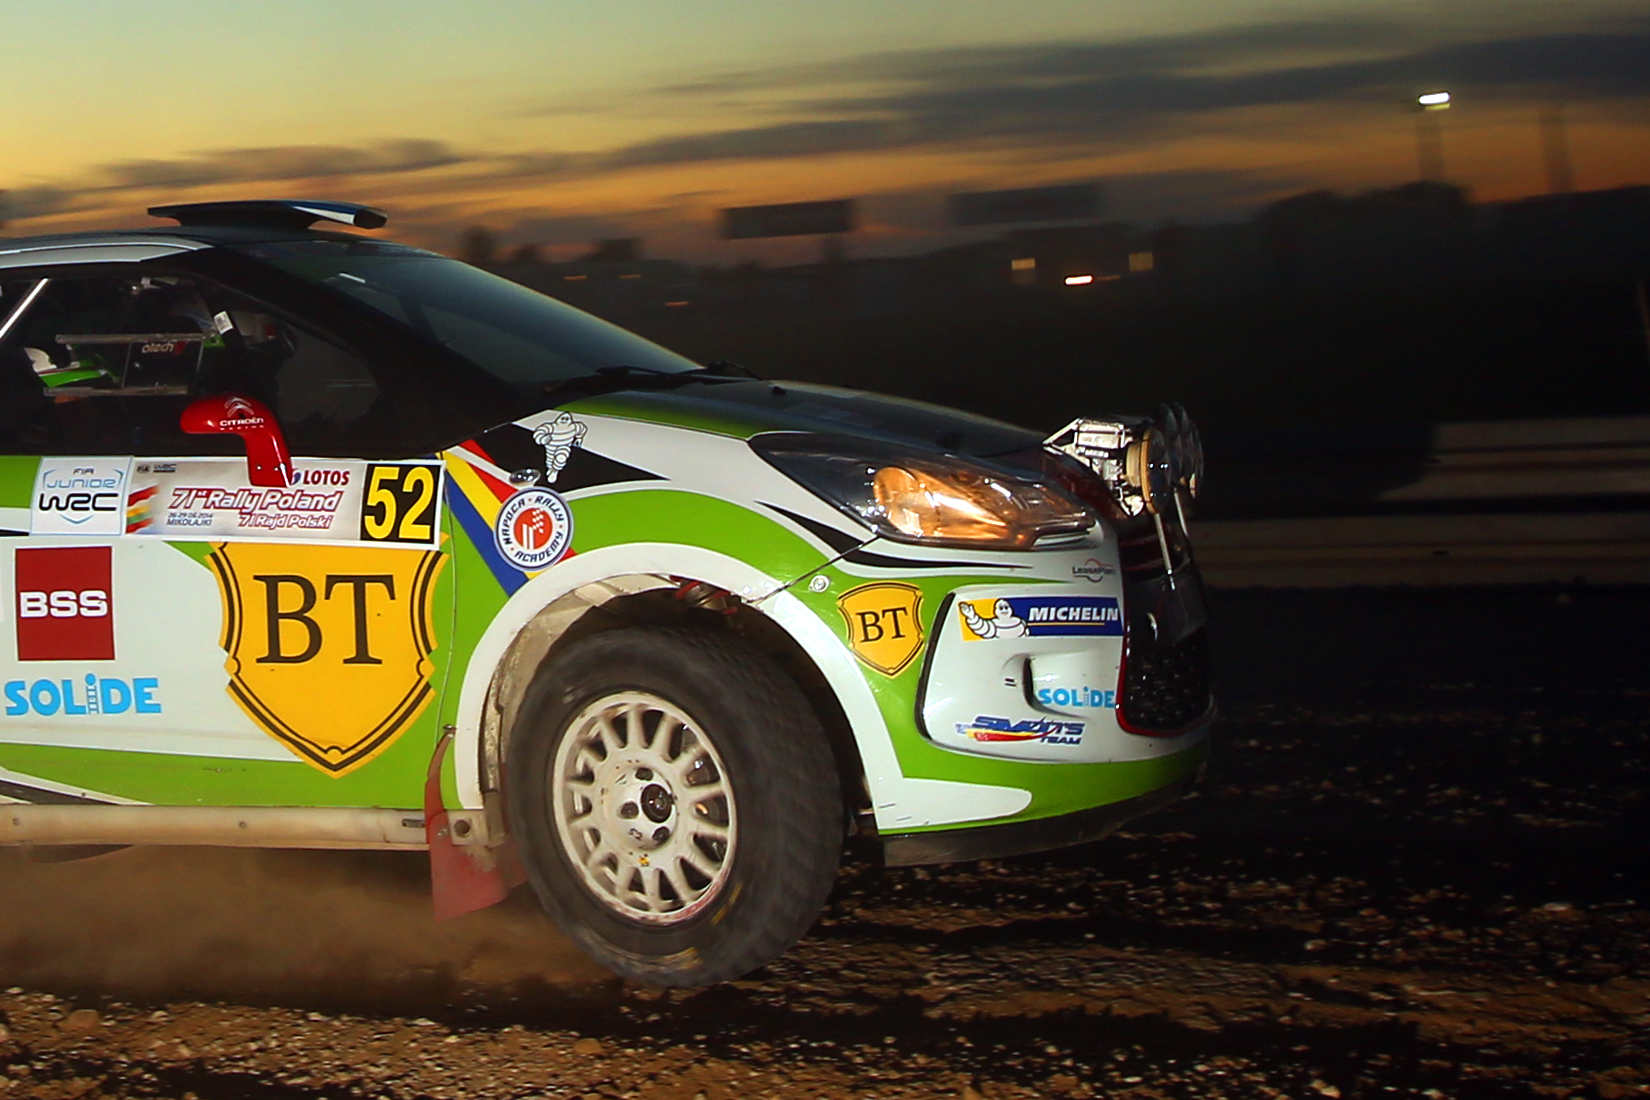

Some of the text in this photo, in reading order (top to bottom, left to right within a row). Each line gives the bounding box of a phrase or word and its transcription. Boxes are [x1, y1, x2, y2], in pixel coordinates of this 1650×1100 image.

[47, 479, 117, 488] JUNIOR
[303, 470, 350, 486] LOTOS
[39, 493, 119, 511] WRC
[203, 488, 262, 514] Rally
[259, 489, 344, 512] Poland
[364, 467, 434, 539] 52
[239, 514, 334, 530] 71 Rajd Polski
[502, 495, 564, 545] NAPOCA RALLY
[514, 532, 564, 562] ACADEMY
[20, 590, 108, 618] BSS
[1029, 607, 1118, 621] MICHELIN
[253, 574, 396, 665] BT
[855, 607, 908, 643] BT
[1040, 736, 1082, 745] TEAM
